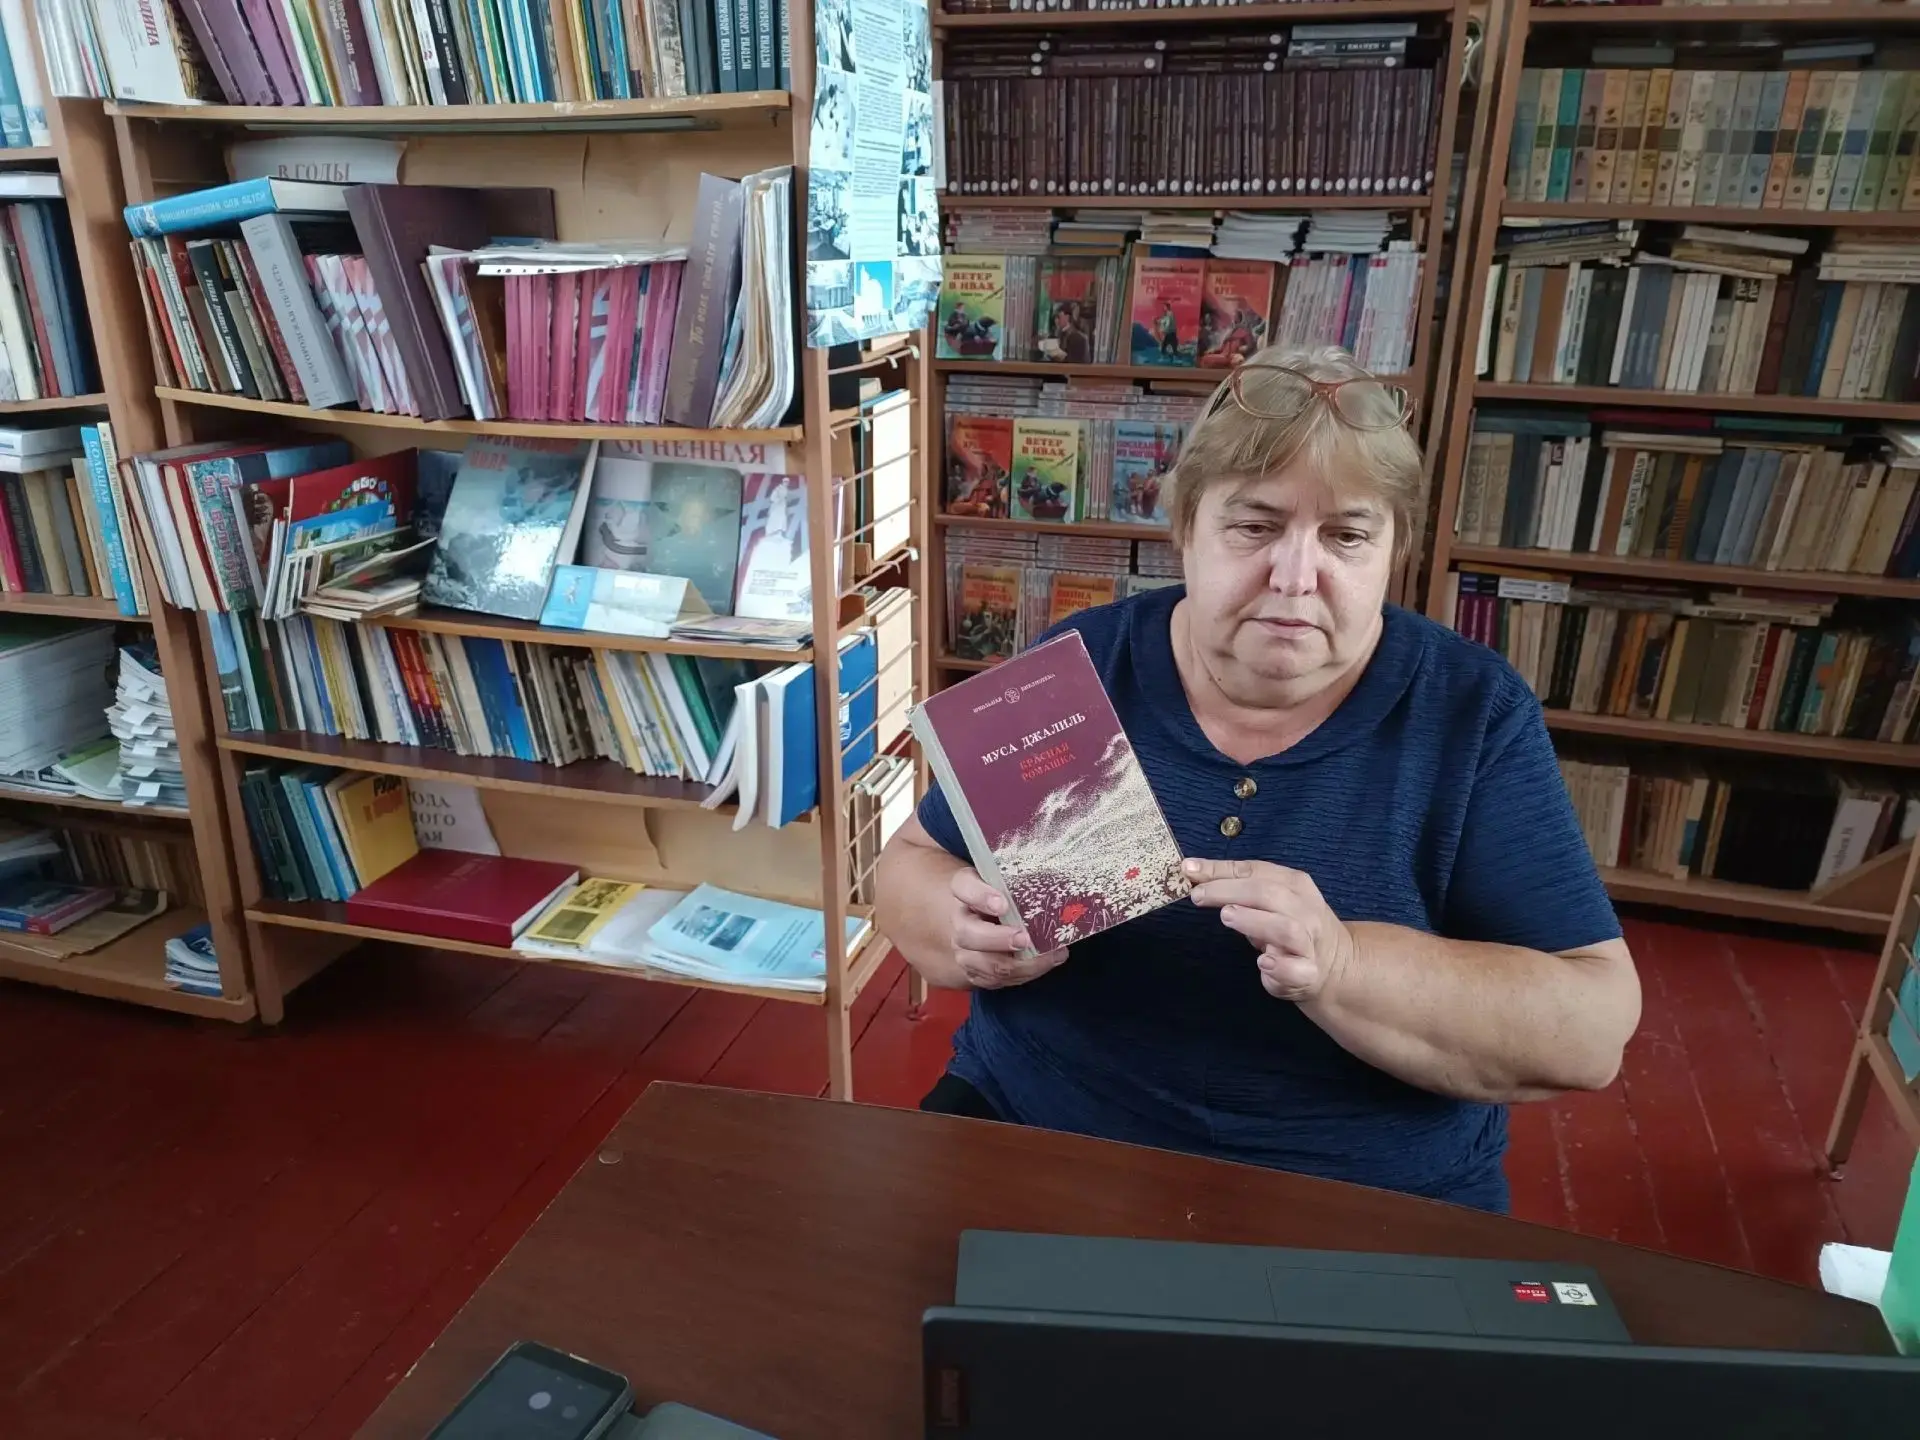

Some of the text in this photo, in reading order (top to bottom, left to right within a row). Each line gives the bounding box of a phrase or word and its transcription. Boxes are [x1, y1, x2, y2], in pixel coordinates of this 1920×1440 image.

[720, 38, 732, 71] ИСТОРИЯ
[740, 37, 752, 70] ИСТОРИЯ
[760, 35, 771, 68] ИСТОРИЯ
[278, 163, 349, 181] В ГОДЫ
[952, 271, 993, 281] ВЕТЕР
[960, 281, 995, 291] ИВАХ
[1024, 436, 1063, 447] ВЕТЕР
[1032, 447, 1067, 458] ИВАХ
[89, 440, 111, 504] БОЛЬШАЯ
[1020, 673, 1056, 692] БИБЛИОТЕКА
[981, 711, 1086, 766] МУСА ДЖАЛИЛЬ
[1020, 741, 1068, 771] КРАСНАЯ
[1022, 753, 1076, 782] РОМАШКА
